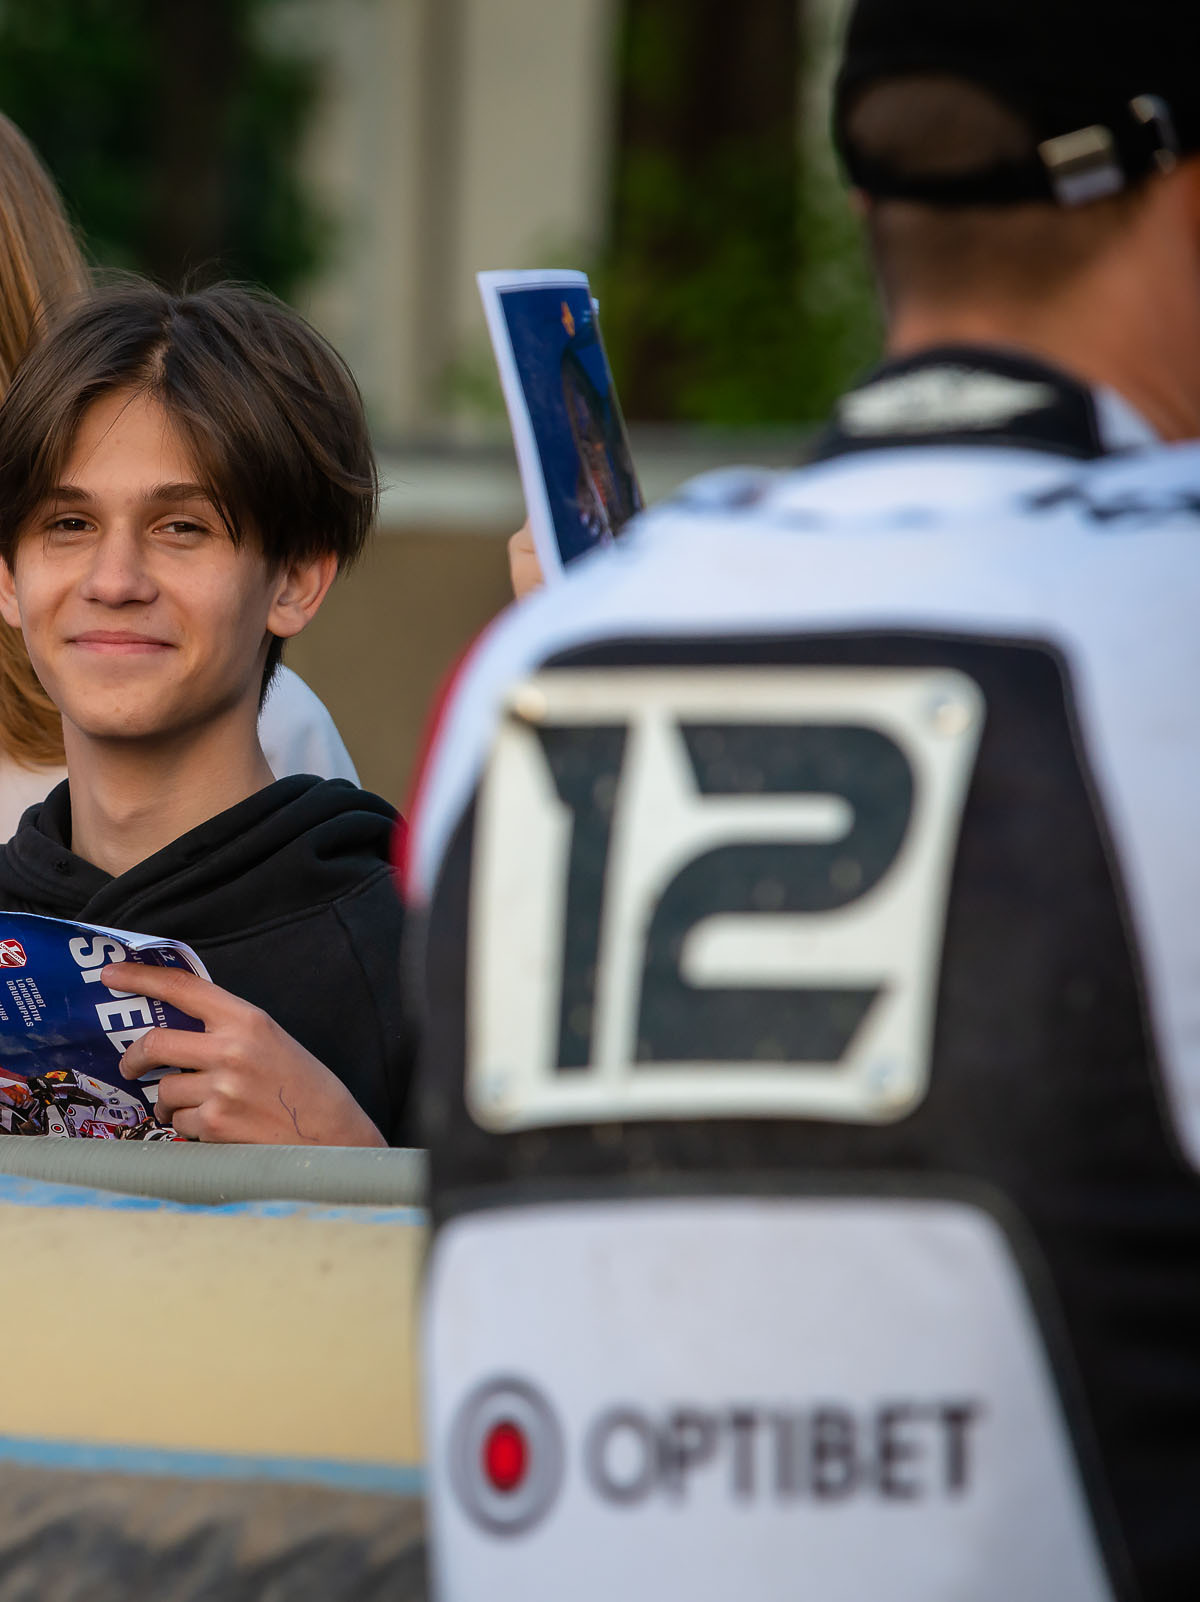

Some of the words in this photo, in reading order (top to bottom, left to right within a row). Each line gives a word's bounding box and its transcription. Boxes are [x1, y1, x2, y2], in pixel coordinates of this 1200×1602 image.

[535, 723, 917, 1070] 12
[15, 979, 43, 1022] LOKOMOTIV
[584, 1394, 985, 1508] OPTIBET
